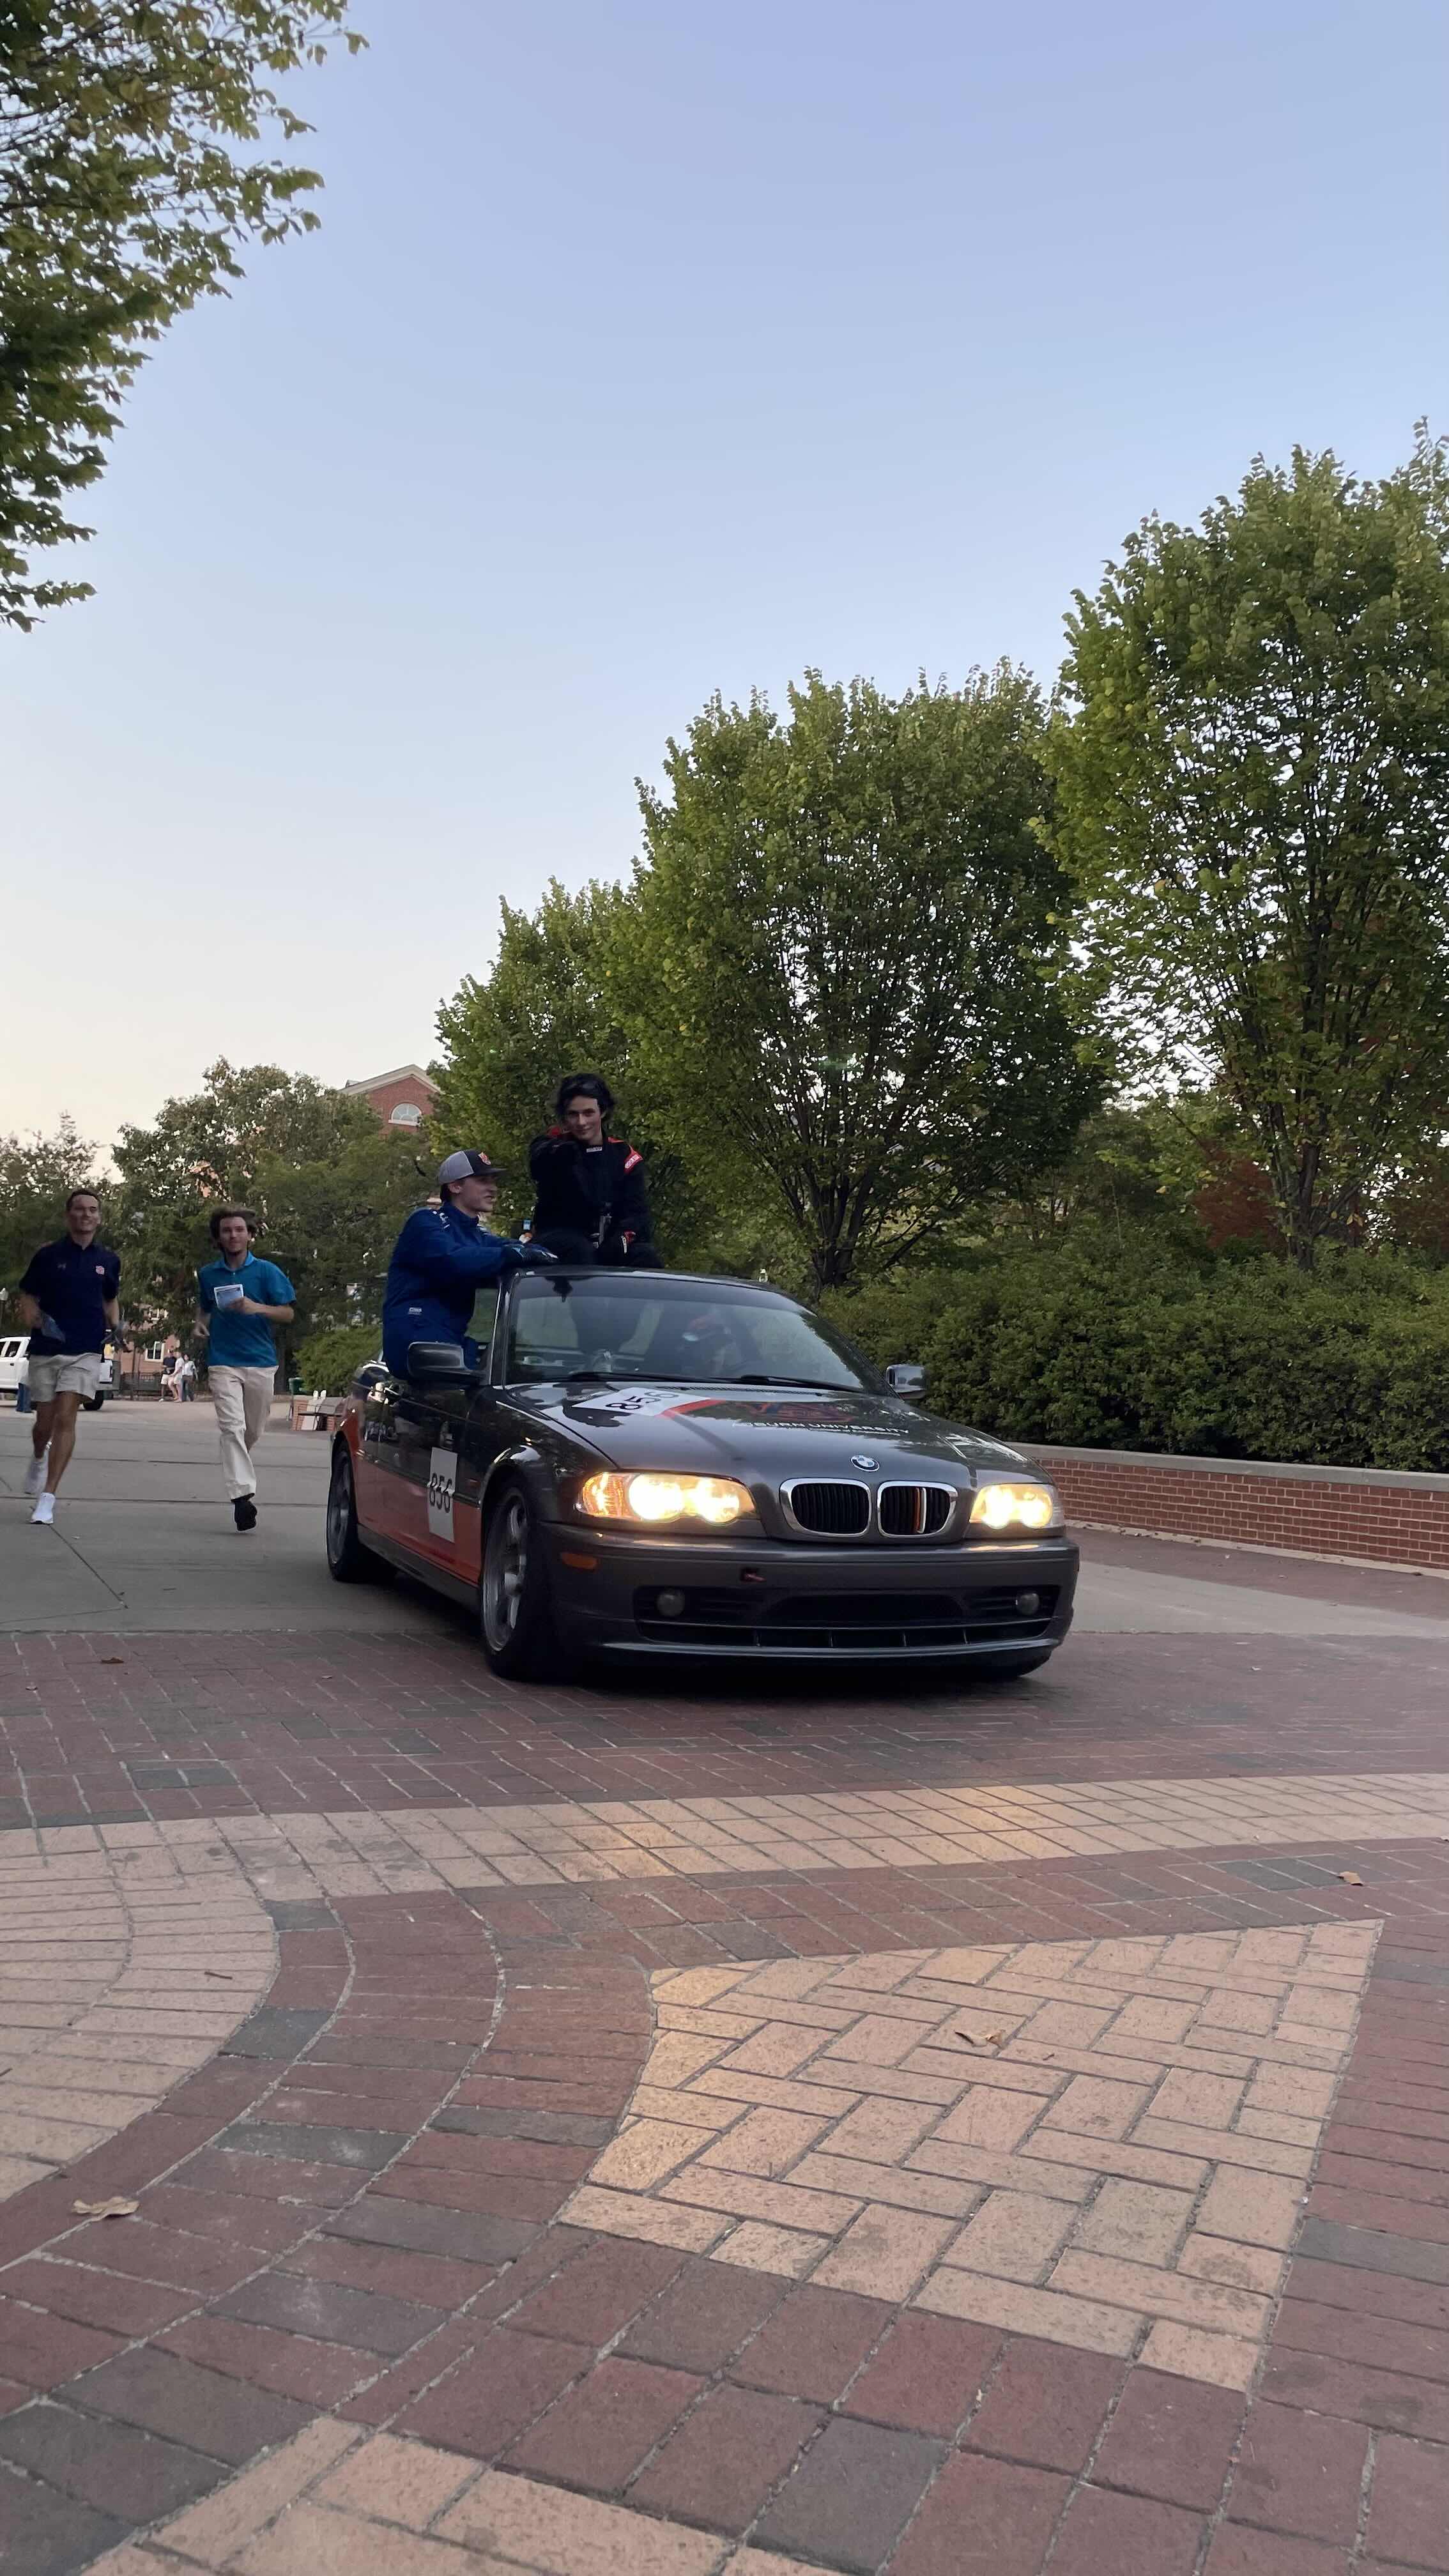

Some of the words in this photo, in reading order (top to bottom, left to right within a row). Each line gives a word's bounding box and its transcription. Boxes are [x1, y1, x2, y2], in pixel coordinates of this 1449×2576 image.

[605, 1391, 679, 1410] 856
[807, 1423, 909, 1434] UNIVERSITY
[429, 1472, 453, 1514] 856
